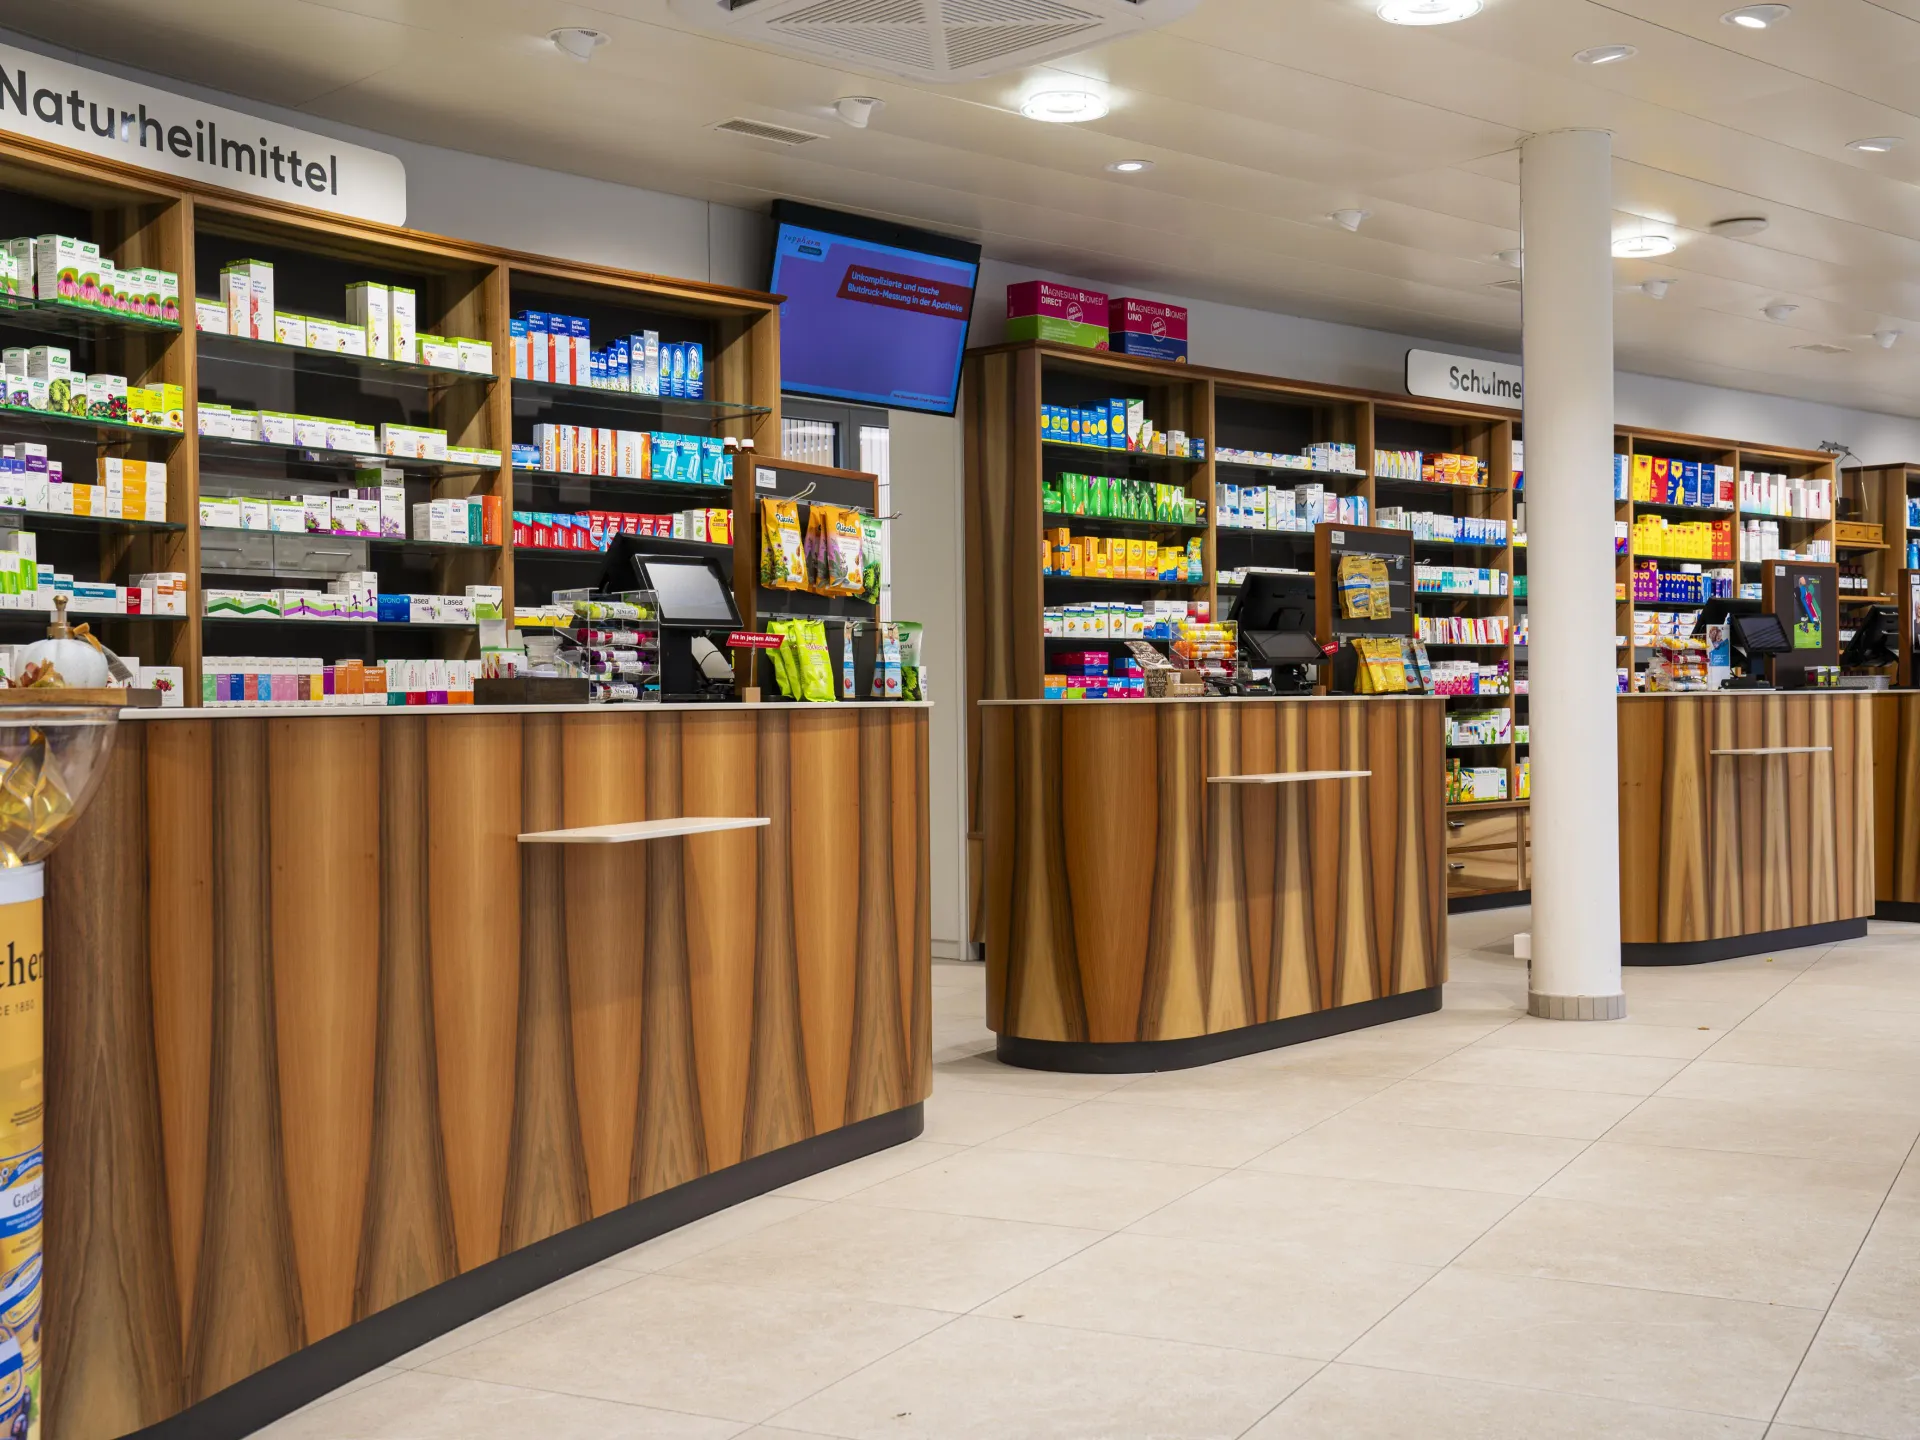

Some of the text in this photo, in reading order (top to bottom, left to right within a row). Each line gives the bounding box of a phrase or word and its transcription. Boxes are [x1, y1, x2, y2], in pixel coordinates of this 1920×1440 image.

[0, 62, 338, 196] Naturheilmittel
[851, 271, 940, 297] Unkomplizierte und rasche
[847, 282, 963, 314] Blutdruck-Messung in der Apotheke
[1041, 296, 1063, 308] DIRECT
[1127, 313, 1142, 322] UNO
[835, 522, 857, 535] Ricola
[410, 597, 429, 605] Lasea
[443, 598, 463, 606] Lasea
[746, 635, 764, 643] jedem
